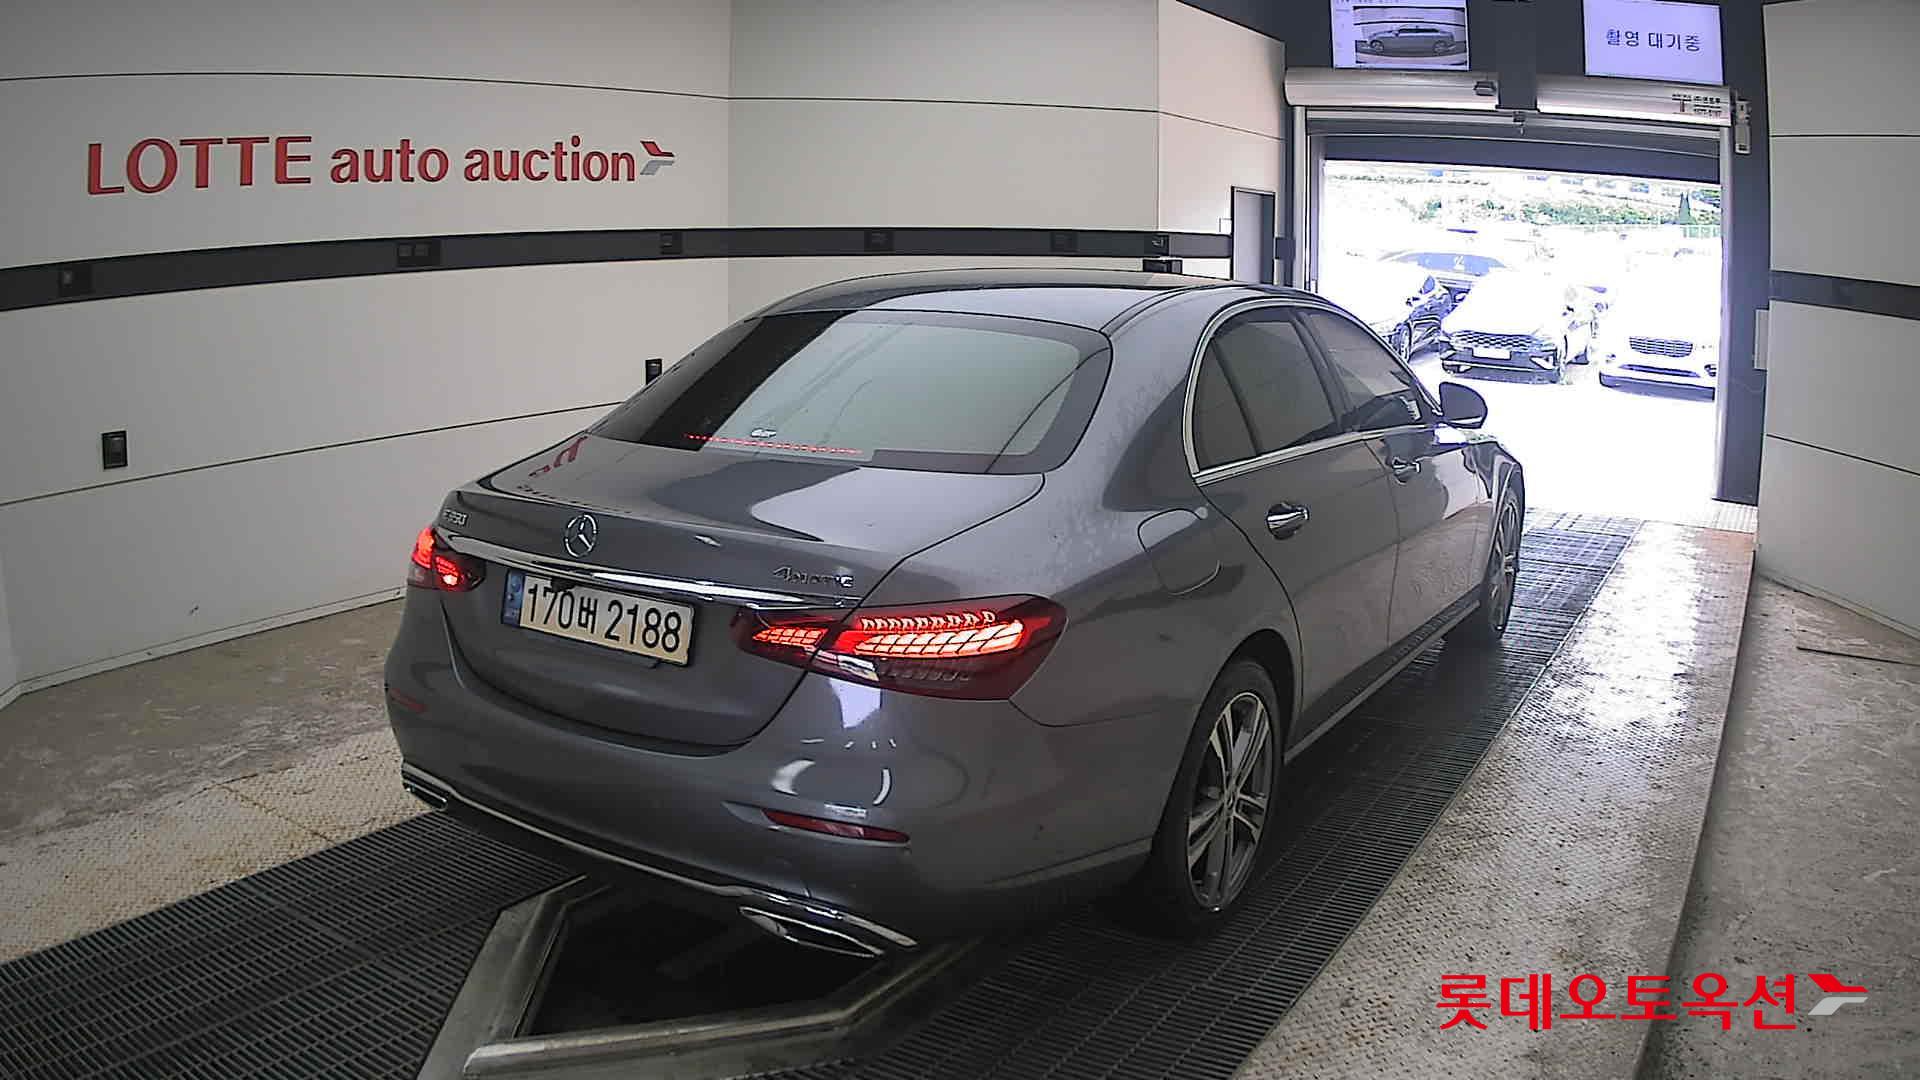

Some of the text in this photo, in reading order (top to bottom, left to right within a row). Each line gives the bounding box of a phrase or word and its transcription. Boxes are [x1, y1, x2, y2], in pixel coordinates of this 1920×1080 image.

[1606, 28, 1701, 52] 촬영 대기중
[87, 134, 636, 195] LOTTE auto auction
[604, 600, 683, 653] 2188
